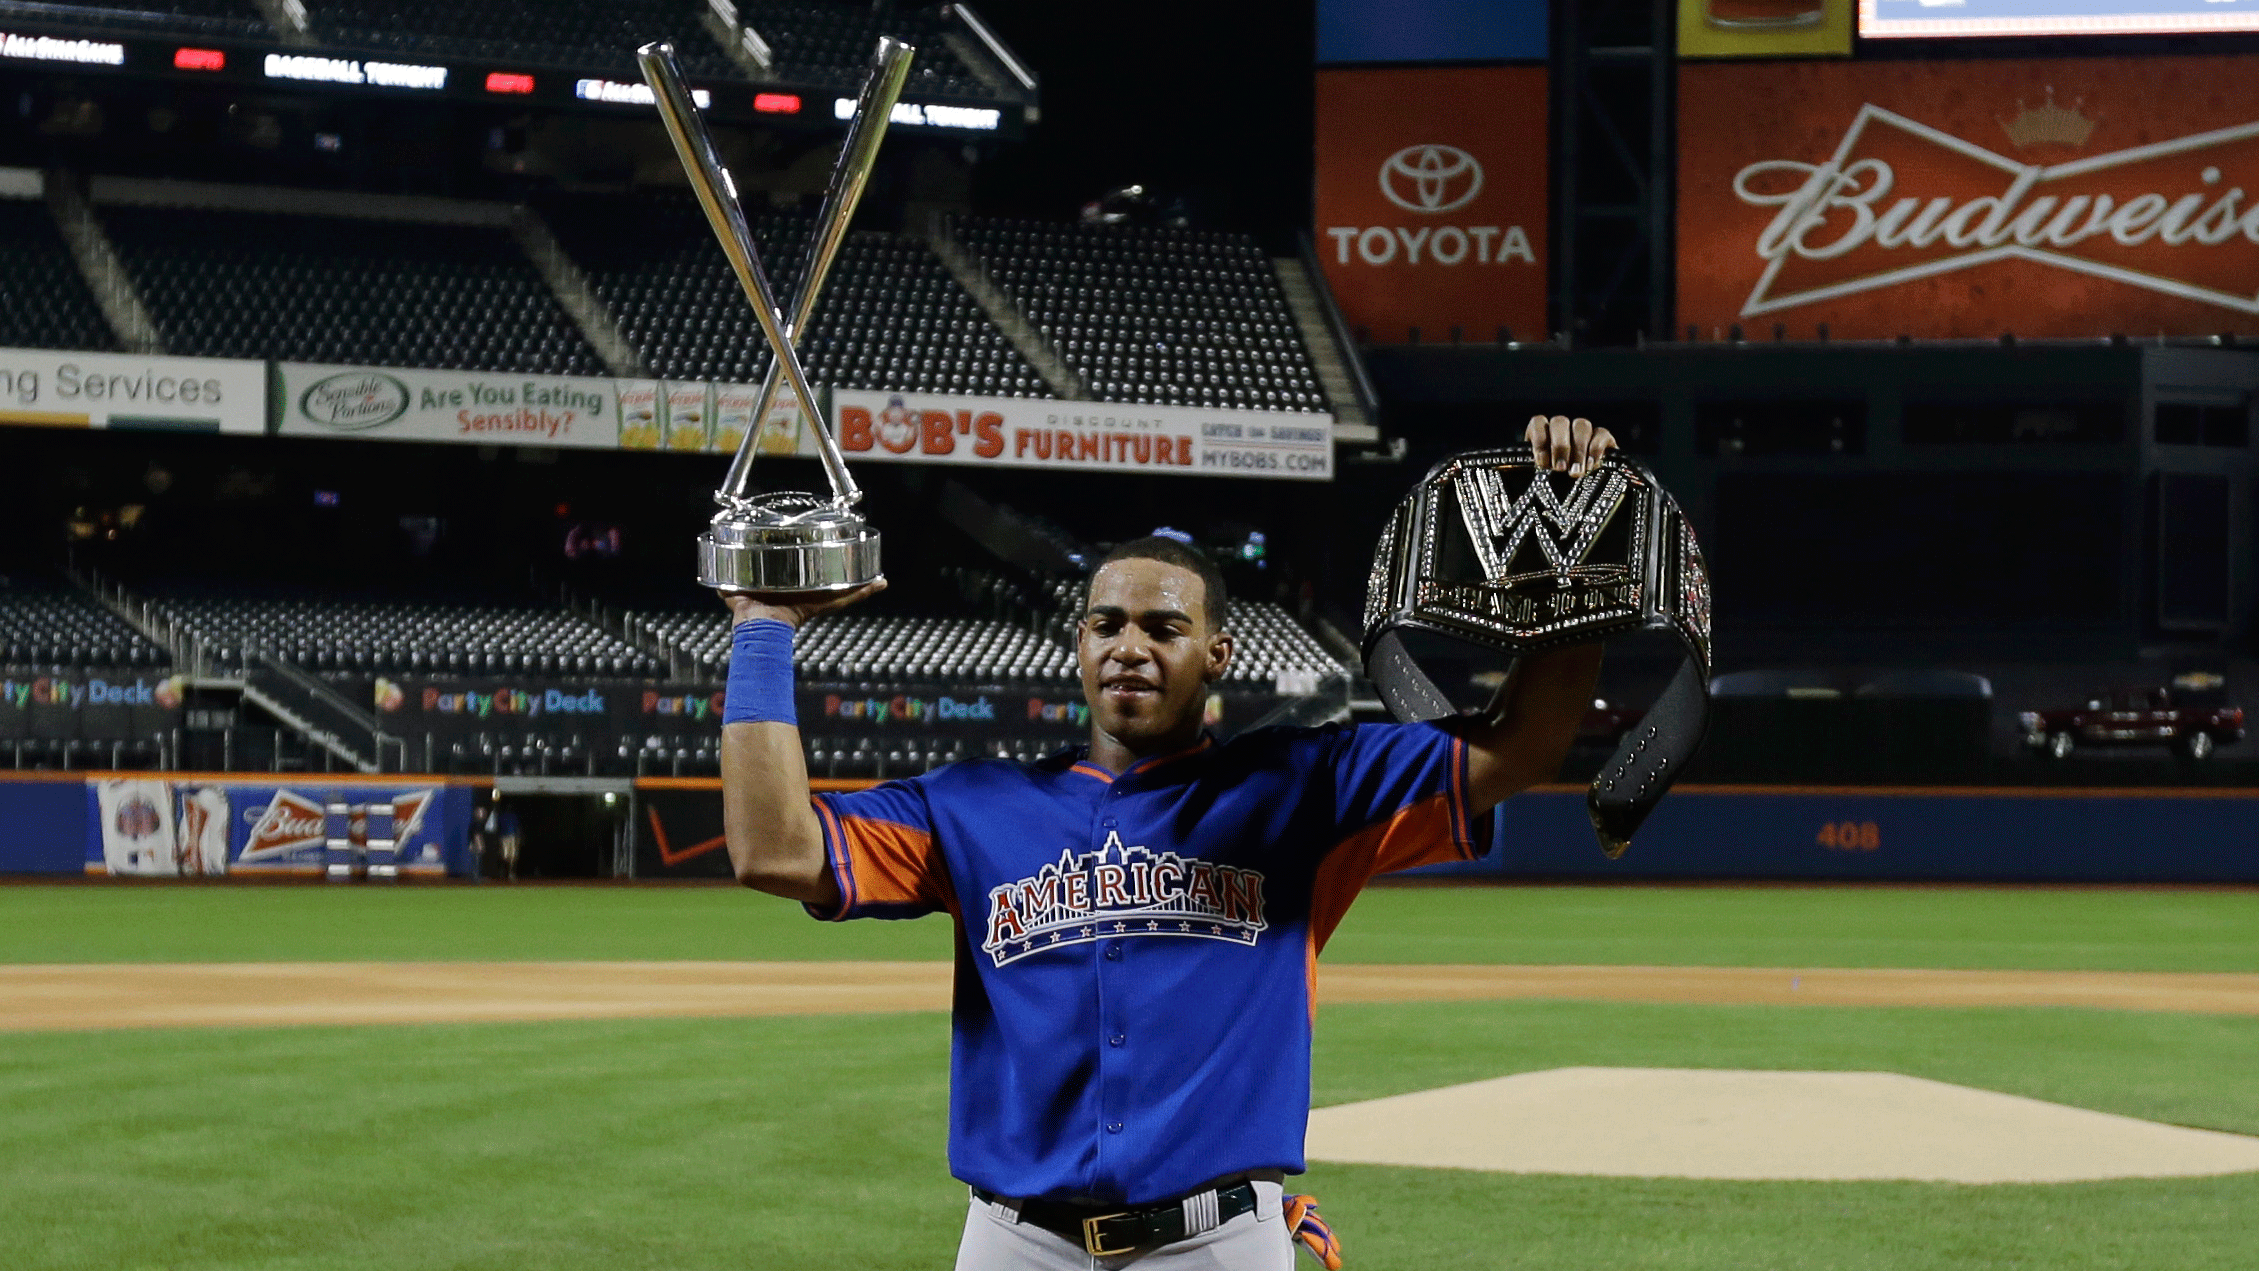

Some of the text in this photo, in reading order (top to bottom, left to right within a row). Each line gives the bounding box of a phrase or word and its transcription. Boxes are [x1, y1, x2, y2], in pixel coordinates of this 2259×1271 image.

[264, 53, 447, 89] BASEBALL TONIGHT
[1326, 225, 1537, 266] TOYOTA
[56, 362, 222, 404] Services
[420, 386, 463, 411] Are
[468, 381, 515, 405] You
[522, 381, 603, 417] Eating
[456, 408, 576, 438] Sensibly?
[839, 404, 1005, 459] BOB'S
[1047, 414, 1164, 429] DISCOUNT
[1014, 428, 1194, 466] FURNITURE
[88, 678, 153, 704] Deck
[545, 688, 604, 713] Deck
[938, 696, 994, 720] Deck
[1816, 821, 1881, 850] 408
[984, 862, 1267, 947] AMERICAN
